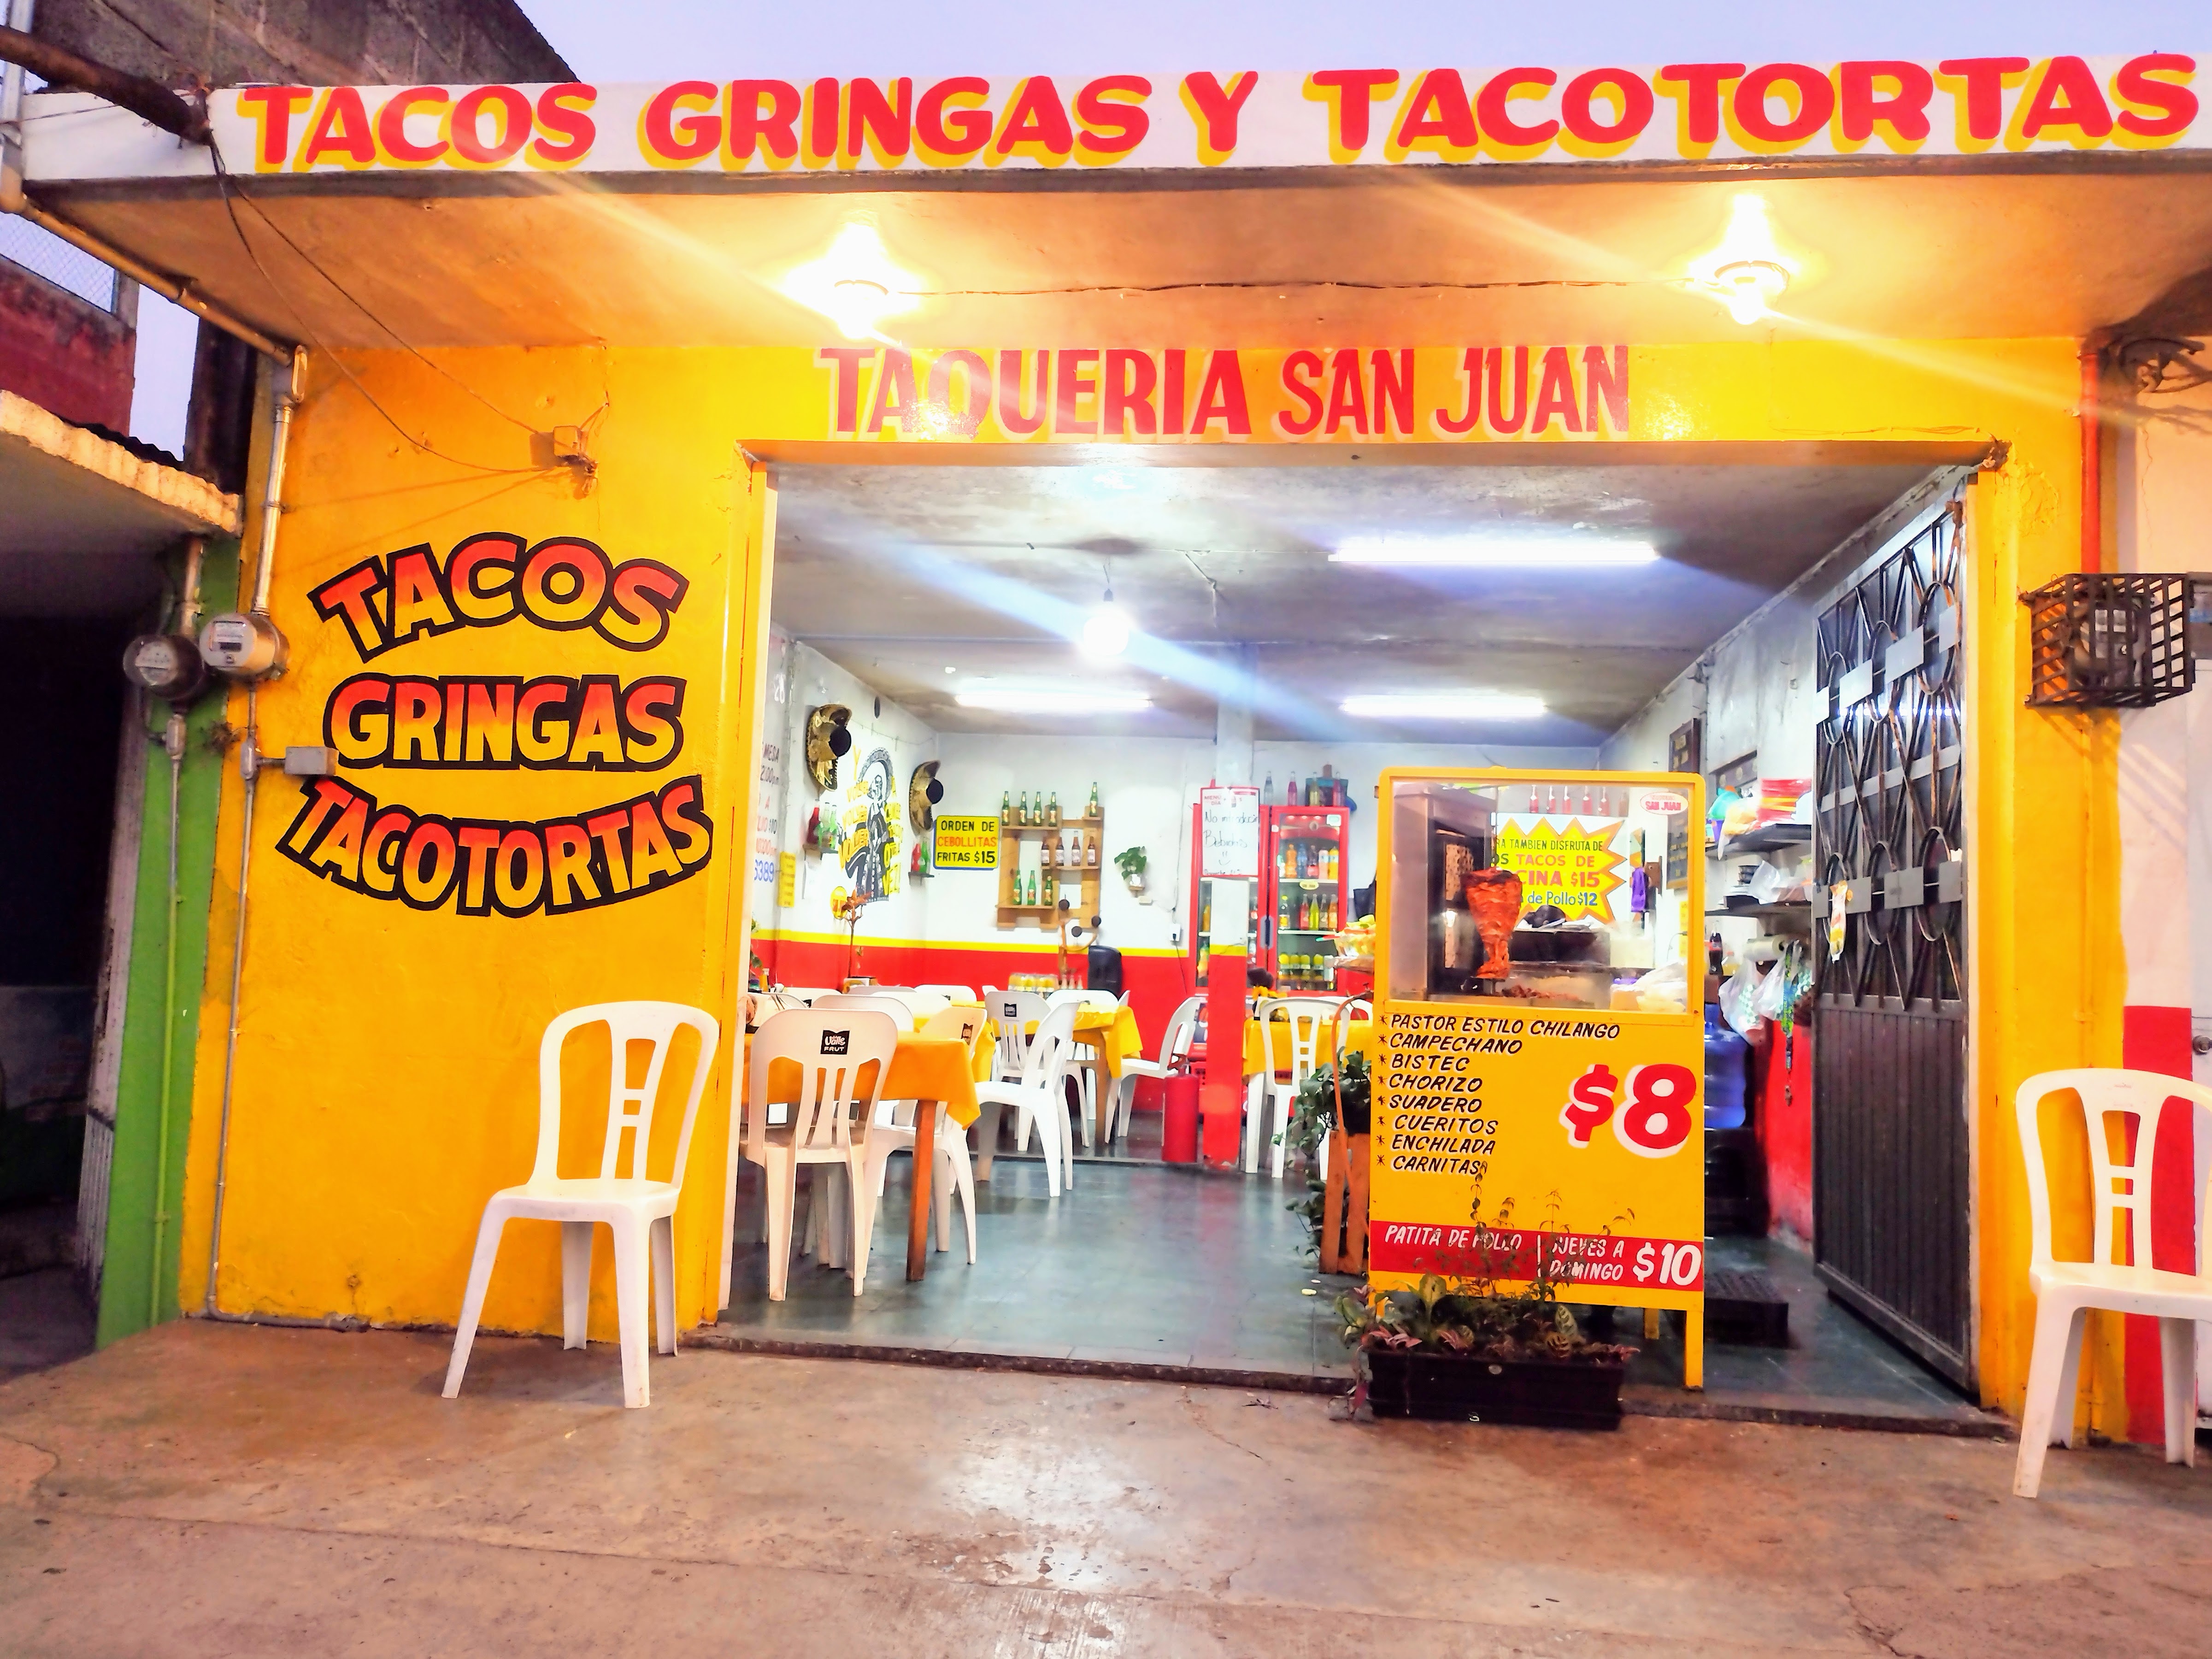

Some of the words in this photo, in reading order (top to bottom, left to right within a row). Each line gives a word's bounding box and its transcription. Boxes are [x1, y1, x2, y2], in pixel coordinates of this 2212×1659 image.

[237, 83, 598, 171] TACOS
[635, 75, 1151, 171] GRINGAS
[1178, 69, 1259, 167] Y
[1303, 53, 2202, 164] TACOTORTAS
[819, 347, 1253, 437] TAQUERIA
[1280, 346, 1415, 435] SAN
[1434, 345, 1629, 434] JUAN
[306, 532, 690, 664] TACOS
[322, 671, 687, 772] GRINGAS
[1205, 809, 1218, 823] No
[1645, 801, 1659, 811] SAN
[1661, 801, 1681, 811] JUAN
[941, 820, 975, 831] ORDEN
[982, 821, 994, 831] DE
[275, 774, 714, 918] TACOTORTAS
[937, 836, 997, 847] CEBOLLITAS
[1510, 839, 1547, 850] TAMBIEN
[1550, 840, 1590, 851] DISFRUTA
[1593, 841, 1603, 851] DE
[937, 852, 971, 862] FRITAS
[974, 851, 995, 864] $15
[1516, 854, 1565, 866] TACOS
[1576, 855, 1595, 867] DE
[1516, 870, 1563, 887] CINA
[1571, 871, 1600, 888] $15
[1528, 891, 1542, 904] de
[1547, 891, 1576, 906] Pollo
[1577, 892, 1598, 906] $12
[1391, 1014, 1457, 1031] PASTOR
[1462, 1017, 1524, 1034] ESTILO
[1530, 1019, 1620, 1039] CHILANGO
[824, 1035, 846, 1046] Valle
[1390, 1032, 1523, 1054] CAMPECHANO
[1391, 1053, 1470, 1071] BISTEC
[1389, 1073, 1483, 1093] CHORIZO
[1389, 1094, 1482, 1113] SUADERO
[1559, 1063, 1697, 1157] $8
[1394, 1114, 1499, 1135] CUERITOS
[1392, 1134, 1496, 1155] ENCHILADA
[1393, 1155, 1481, 1175] CARNITAS
[1384, 1224, 1442, 1247] PATITA
[1448, 1229, 1470, 1248] DE
[1552, 1236, 1606, 1258] JUEVES
[1612, 1240, 1624, 1258] A
[1549, 1259, 1624, 1281] DOMINGO
[1632, 1241, 1702, 1286] $10
